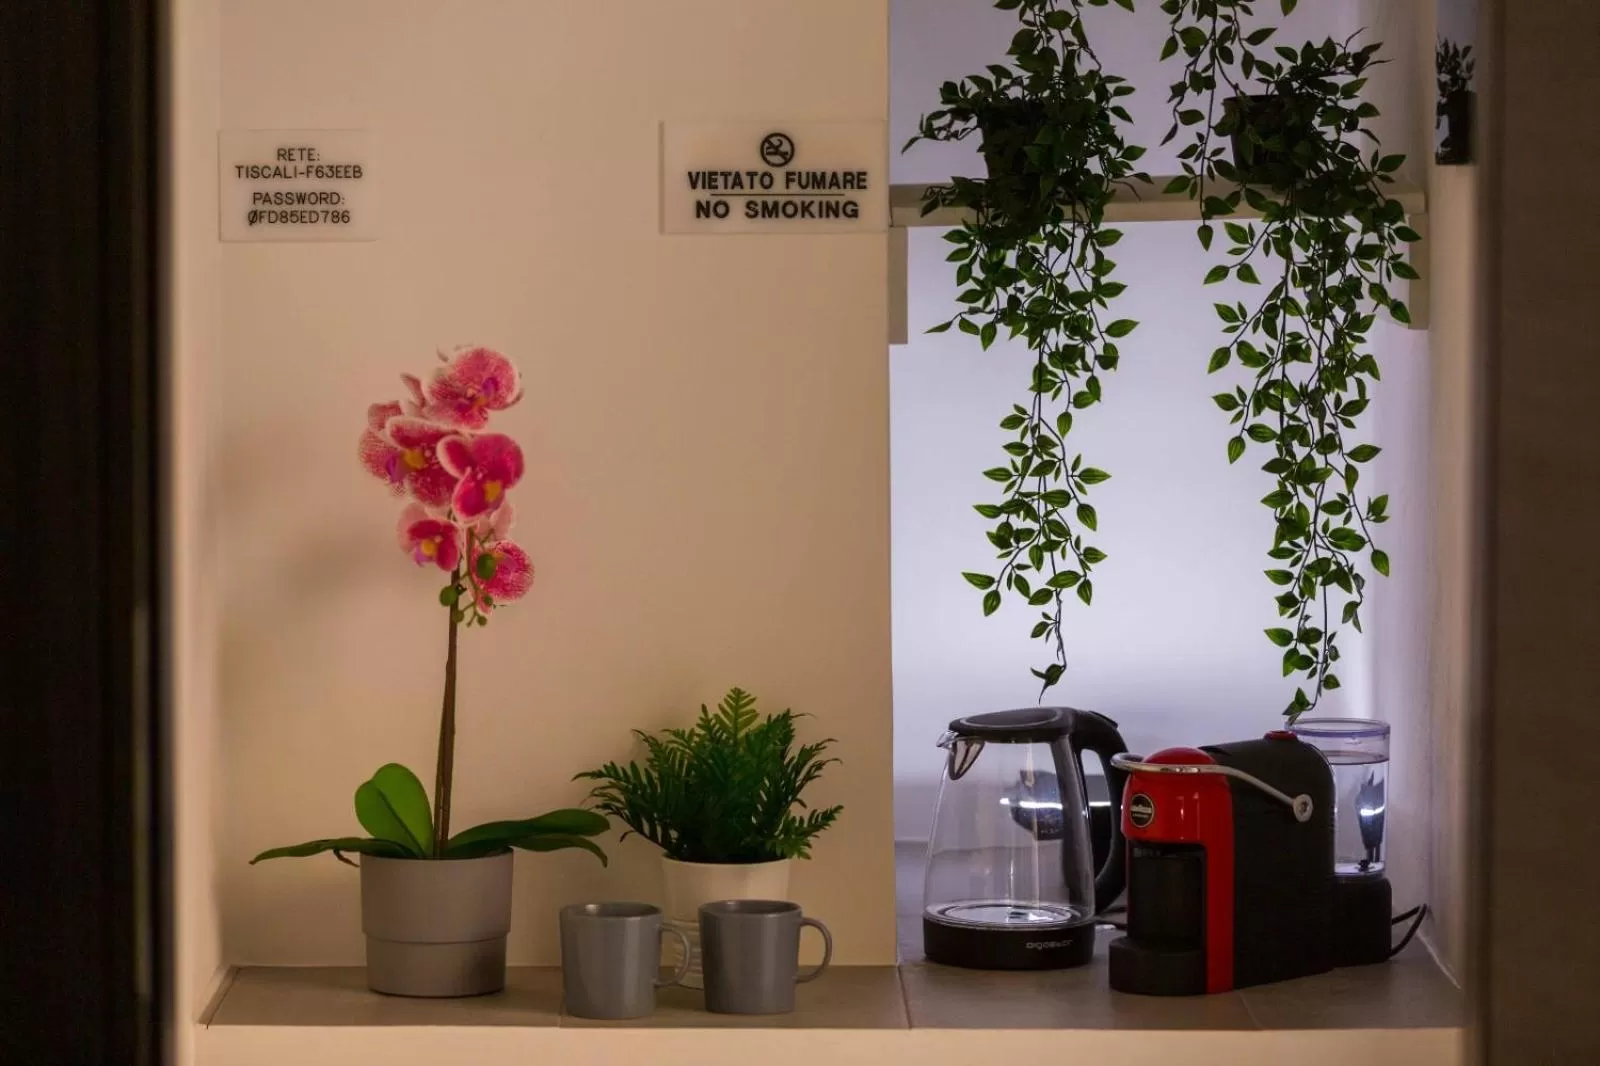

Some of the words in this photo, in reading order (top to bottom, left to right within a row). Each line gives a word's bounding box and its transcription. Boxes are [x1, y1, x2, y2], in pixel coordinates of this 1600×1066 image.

[276, 147, 321, 162] RETE:
[234, 164, 363, 179] TISCALI-F63EEB
[687, 171, 774, 190] VIETATO
[785, 171, 868, 190] FUMARE
[252, 191, 346, 206] PASSWORD:
[695, 200, 730, 219] NO
[744, 200, 860, 219] SMOKING
